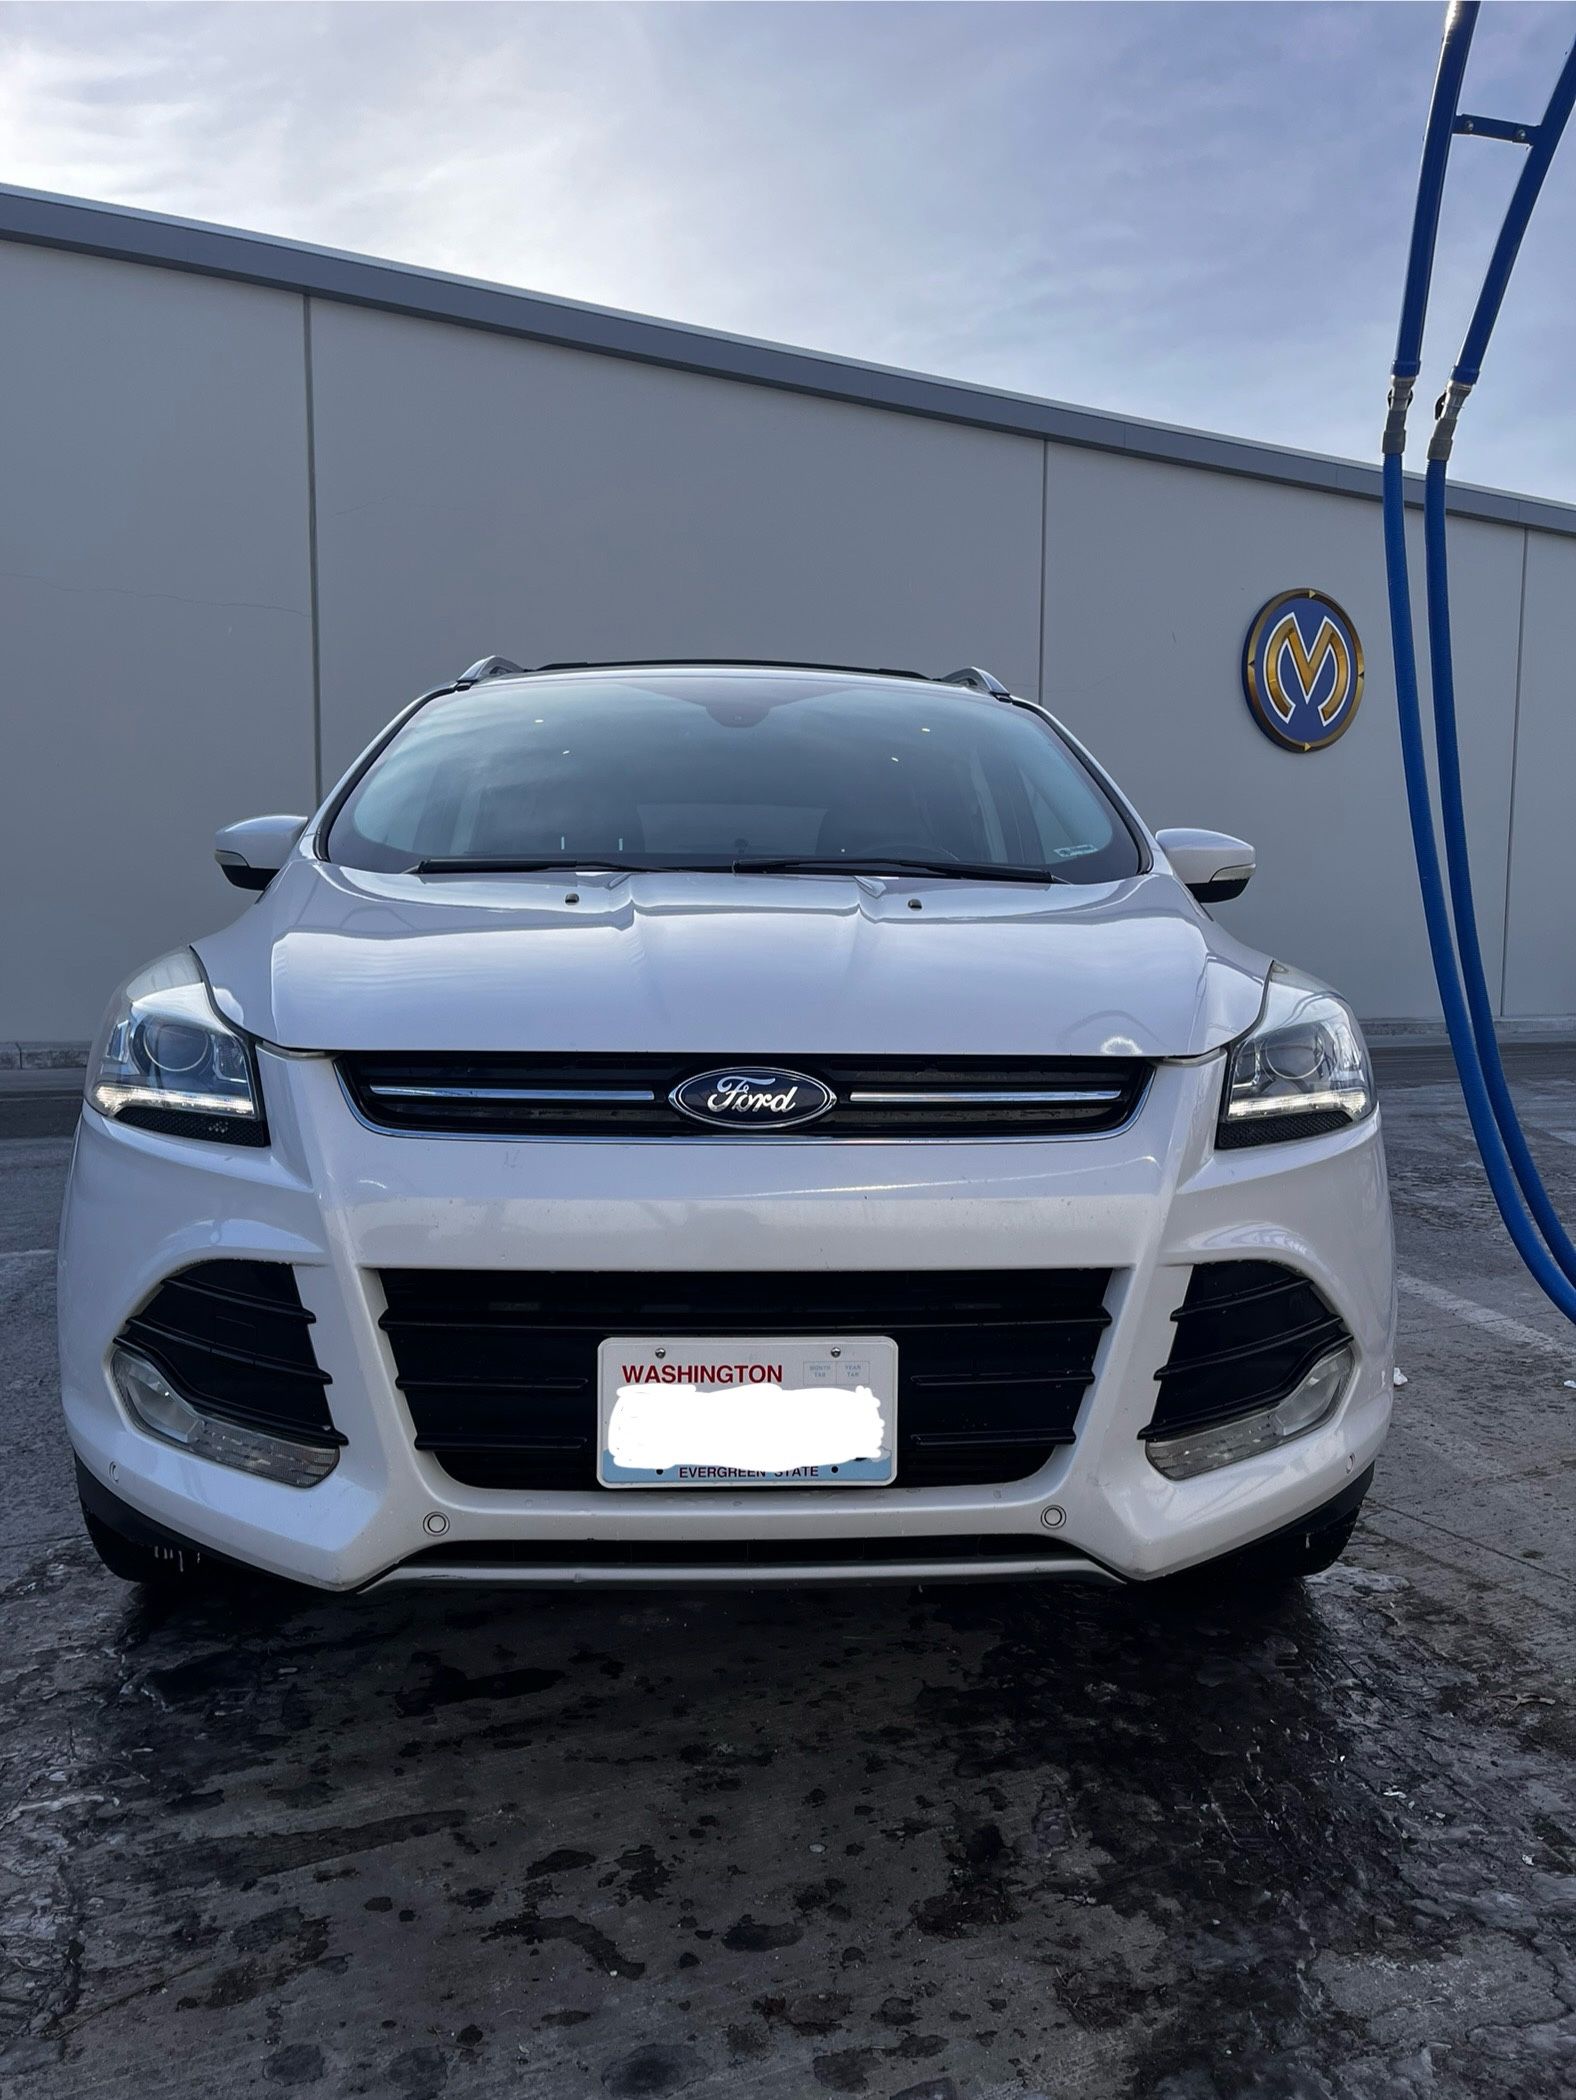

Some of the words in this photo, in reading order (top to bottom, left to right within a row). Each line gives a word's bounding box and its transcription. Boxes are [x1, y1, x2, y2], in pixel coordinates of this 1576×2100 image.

[1263, 611, 1351, 727] M
[707, 1075, 798, 1112] Ford
[622, 1364, 783, 1384] WASHINGTON
[679, 1466, 766, 1478] EVERGREEN
